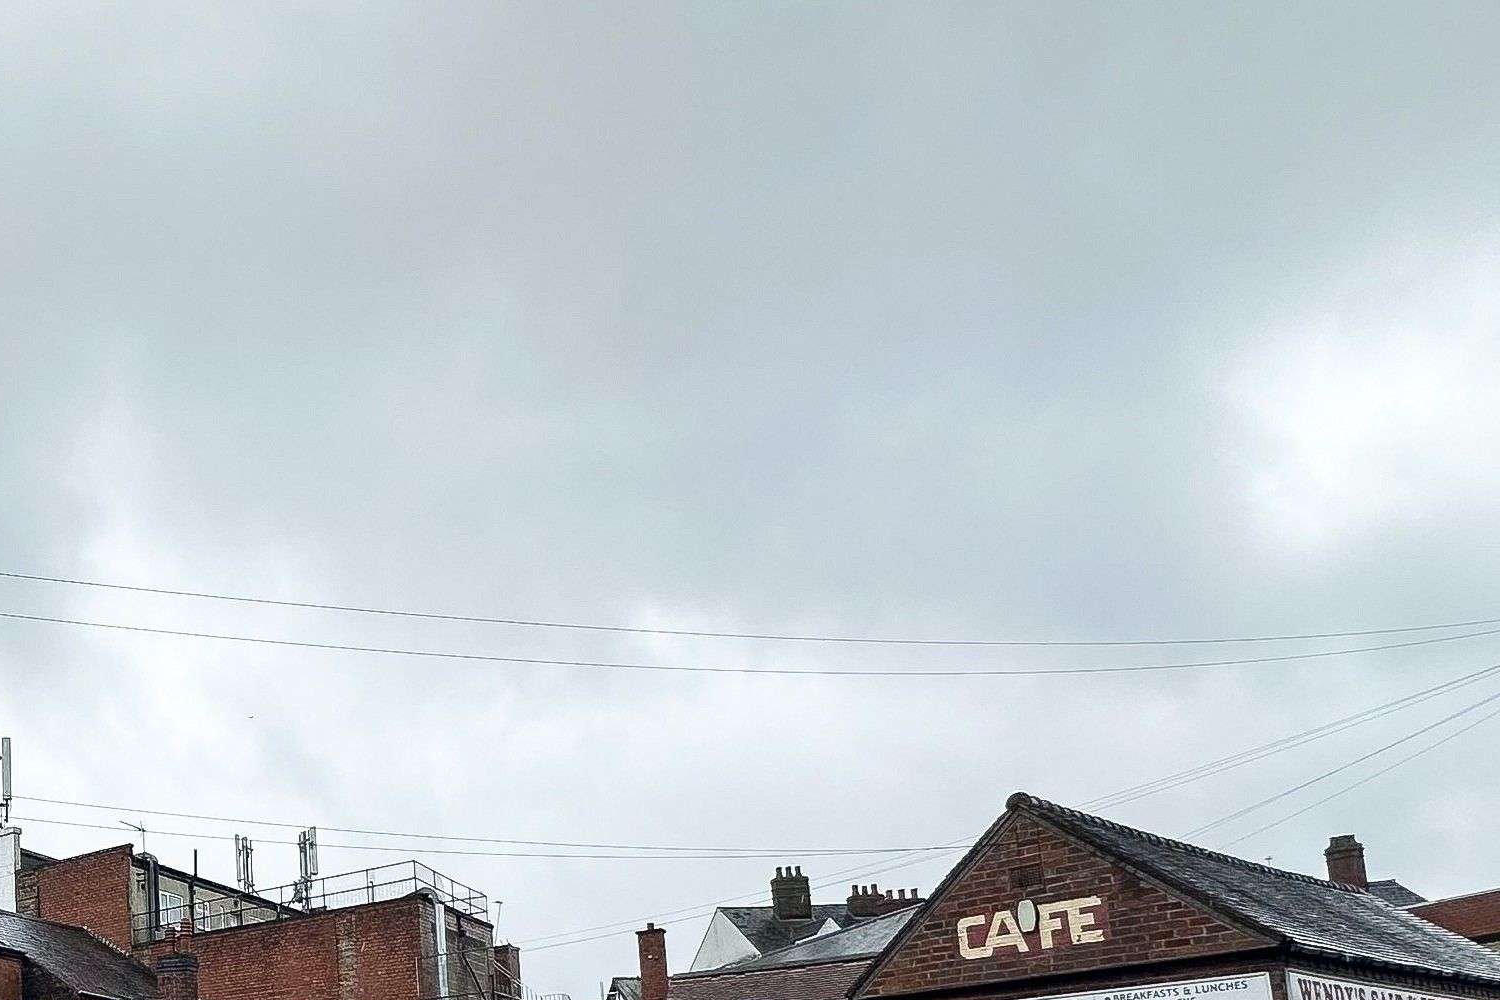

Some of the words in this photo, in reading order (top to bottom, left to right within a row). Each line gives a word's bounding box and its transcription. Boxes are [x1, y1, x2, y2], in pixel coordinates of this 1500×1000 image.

[957, 896, 1105, 960] CAFE
[1183, 987, 1191, 995] &
[1195, 981, 1248, 994] LUNCHES
